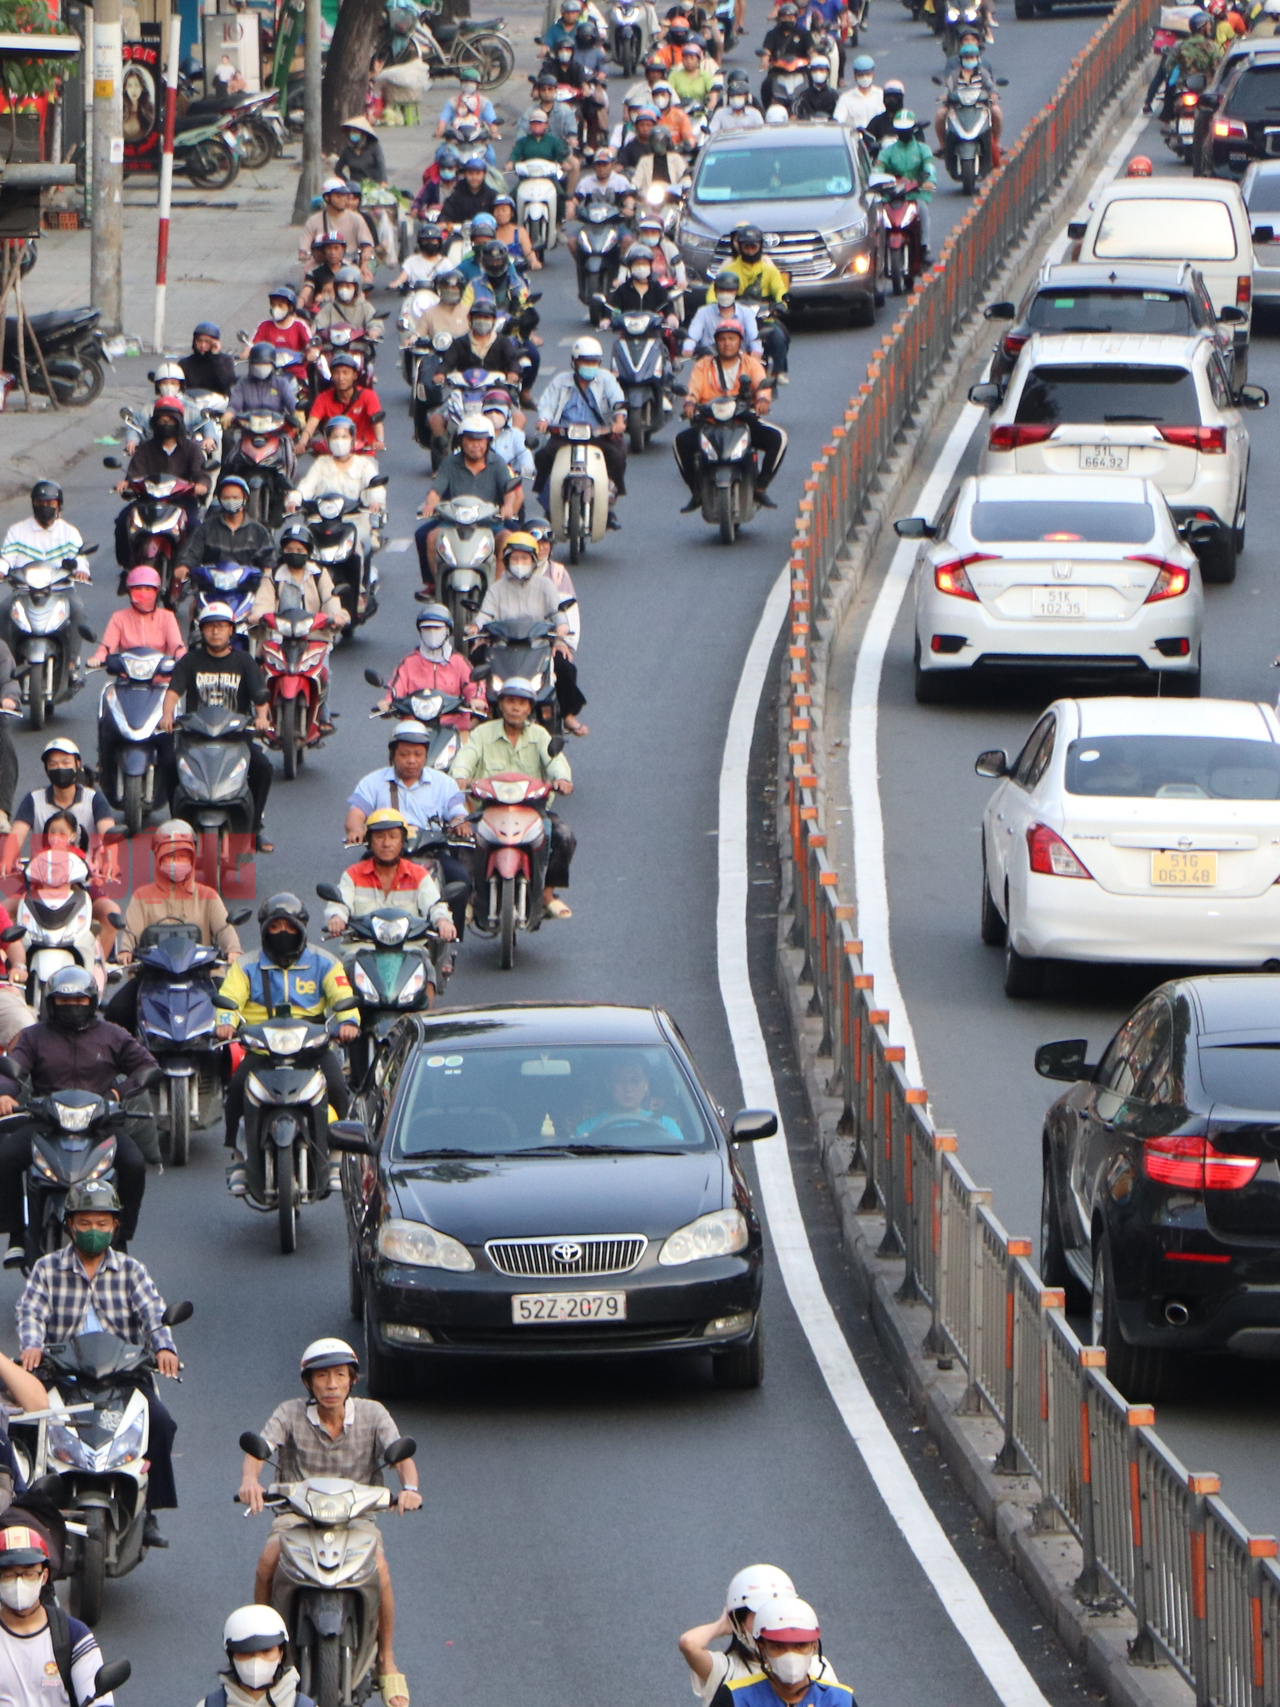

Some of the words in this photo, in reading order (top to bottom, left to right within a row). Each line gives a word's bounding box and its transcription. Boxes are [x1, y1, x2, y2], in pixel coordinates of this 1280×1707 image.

[1095, 445, 1115, 457] 51L
[1085, 457, 1124, 469] 664.92
[1048, 590, 1071, 602] 51K
[1040, 603, 1082, 615] 102.35
[1170, 854, 1199, 867] 51G
[1159, 869, 1211, 883] 063.48
[296, 976, 317, 995] be
